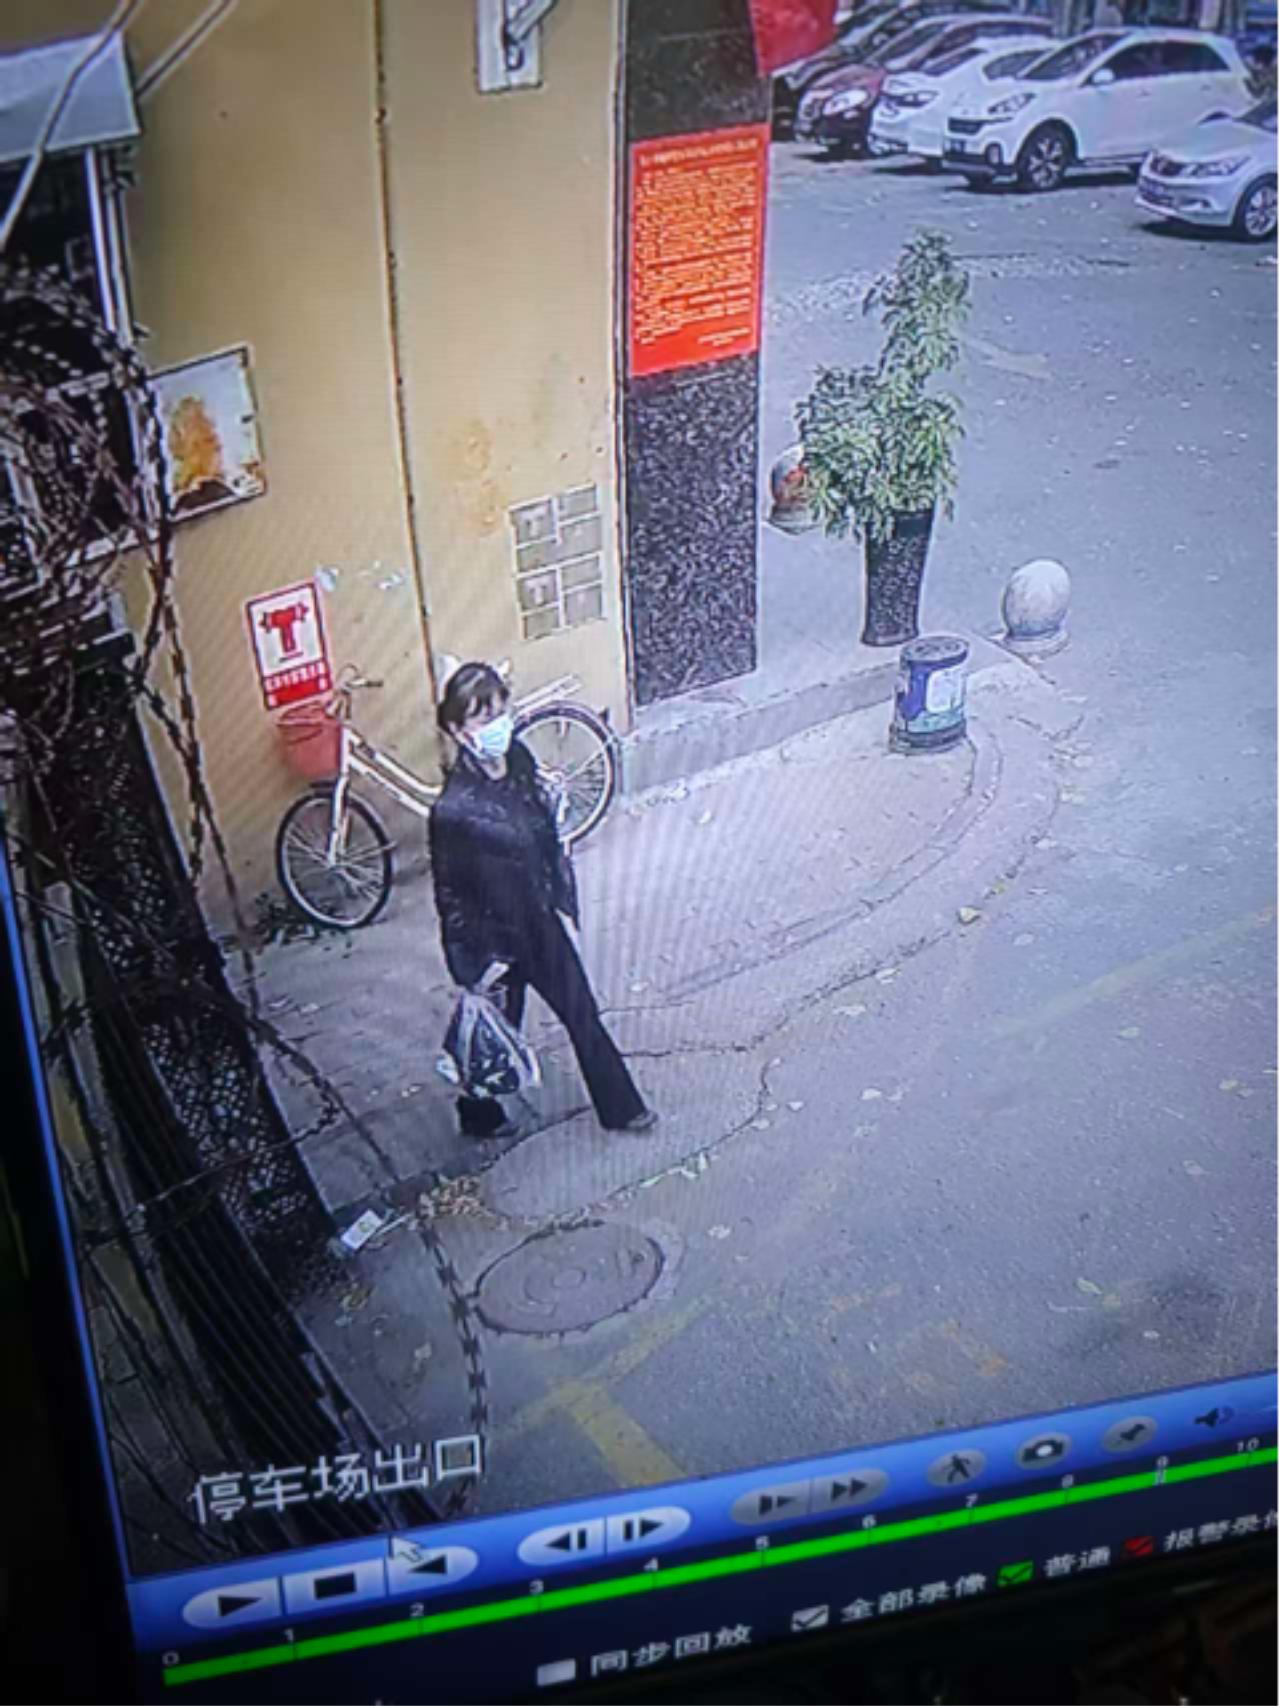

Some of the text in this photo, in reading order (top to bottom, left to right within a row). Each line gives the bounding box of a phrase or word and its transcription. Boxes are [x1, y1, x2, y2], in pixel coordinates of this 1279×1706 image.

[187, 1434, 481, 1524] 停车场出口
[284, 1628, 295, 1642] 1
[410, 1602, 425, 1617] 2
[529, 1579, 545, 1595] 3
[643, 1557, 659, 1572] 4
[755, 1535, 770, 1550] 5
[861, 1514, 877, 1529] 6
[966, 1494, 978, 1508] 7
[1236, 1437, 1260, 1453] 10
[1044, 1546, 1111, 1577] 普通
[840, 1573, 987, 1623] 全部录像
[590, 1623, 753, 1678] 同步回放
